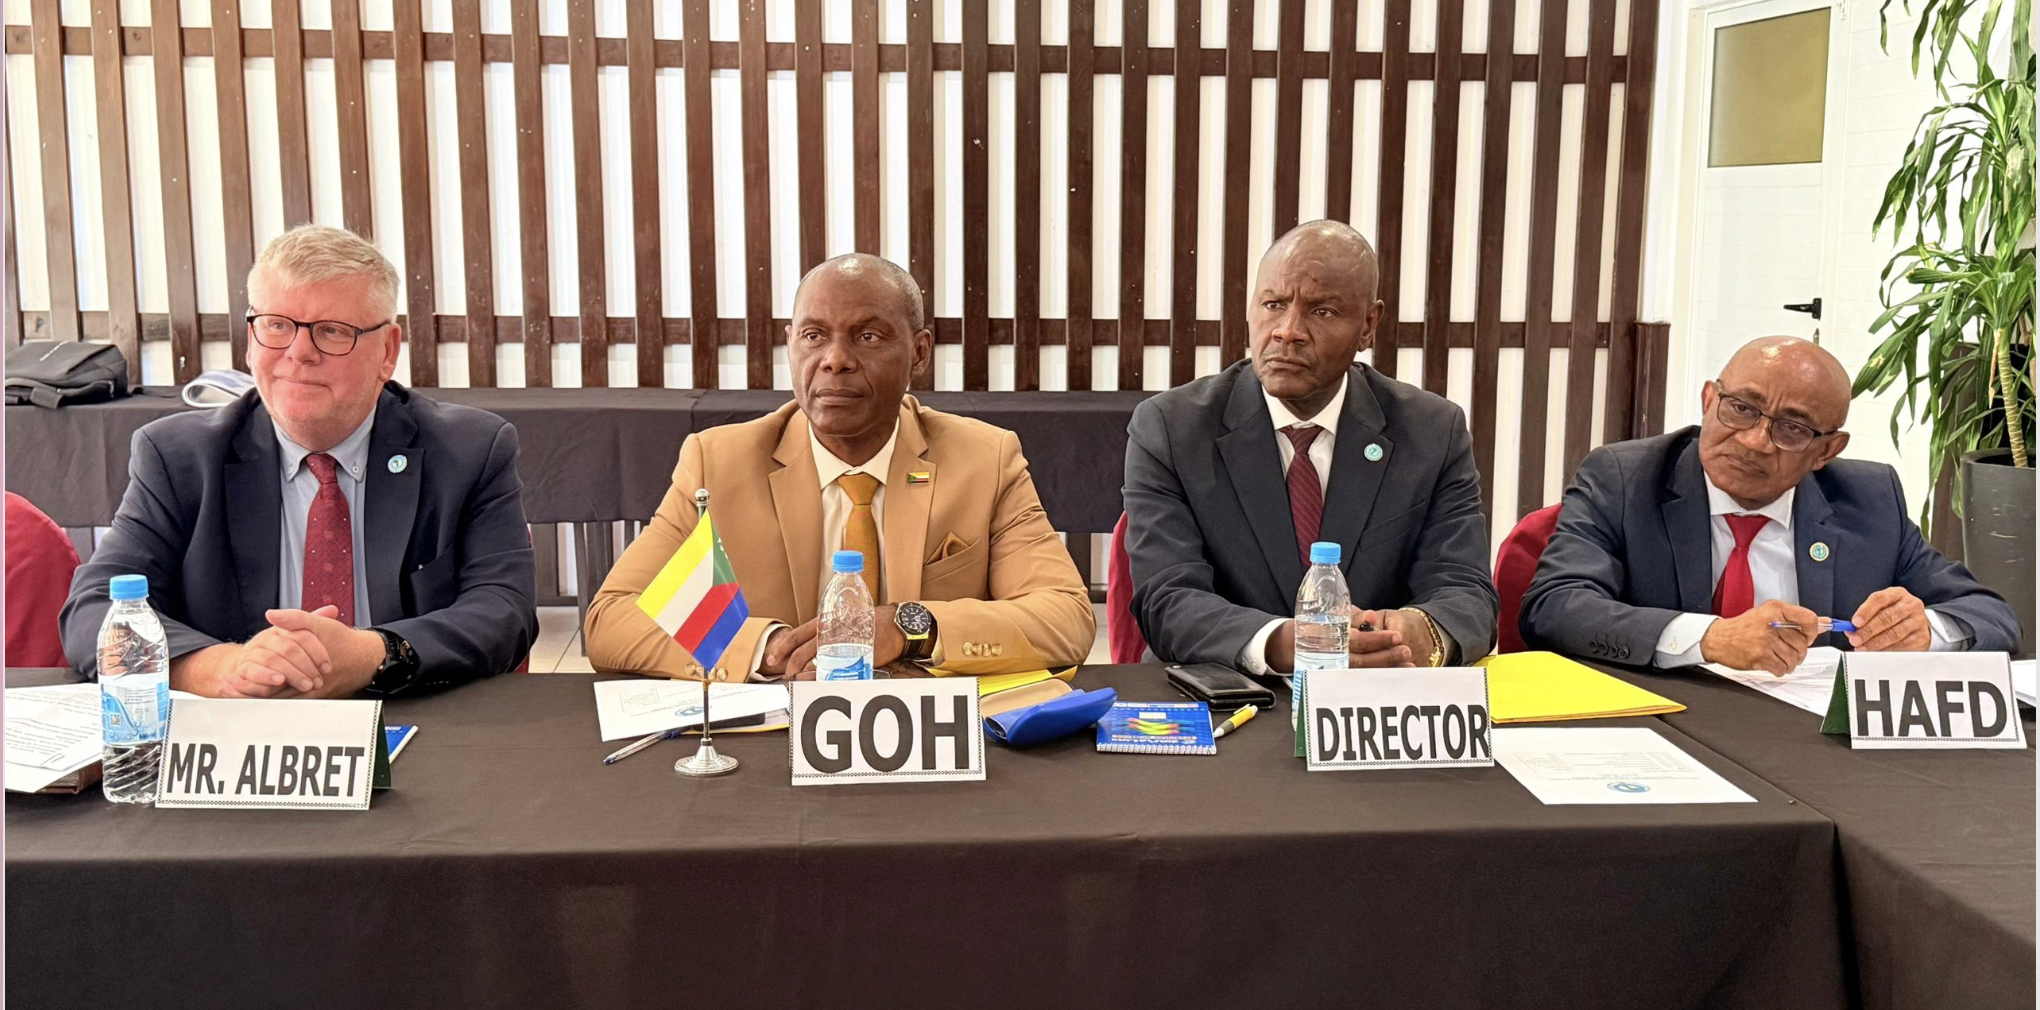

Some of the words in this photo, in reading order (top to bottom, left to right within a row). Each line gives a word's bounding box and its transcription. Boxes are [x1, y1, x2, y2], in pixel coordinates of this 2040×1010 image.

[801, 694, 970, 774] GOH
[1317, 704, 1490, 761] DIRECTOR
[1855, 680, 2008, 738] HAFD
[166, 743, 225, 795] MR.
[234, 745, 365, 797] ALBRET
